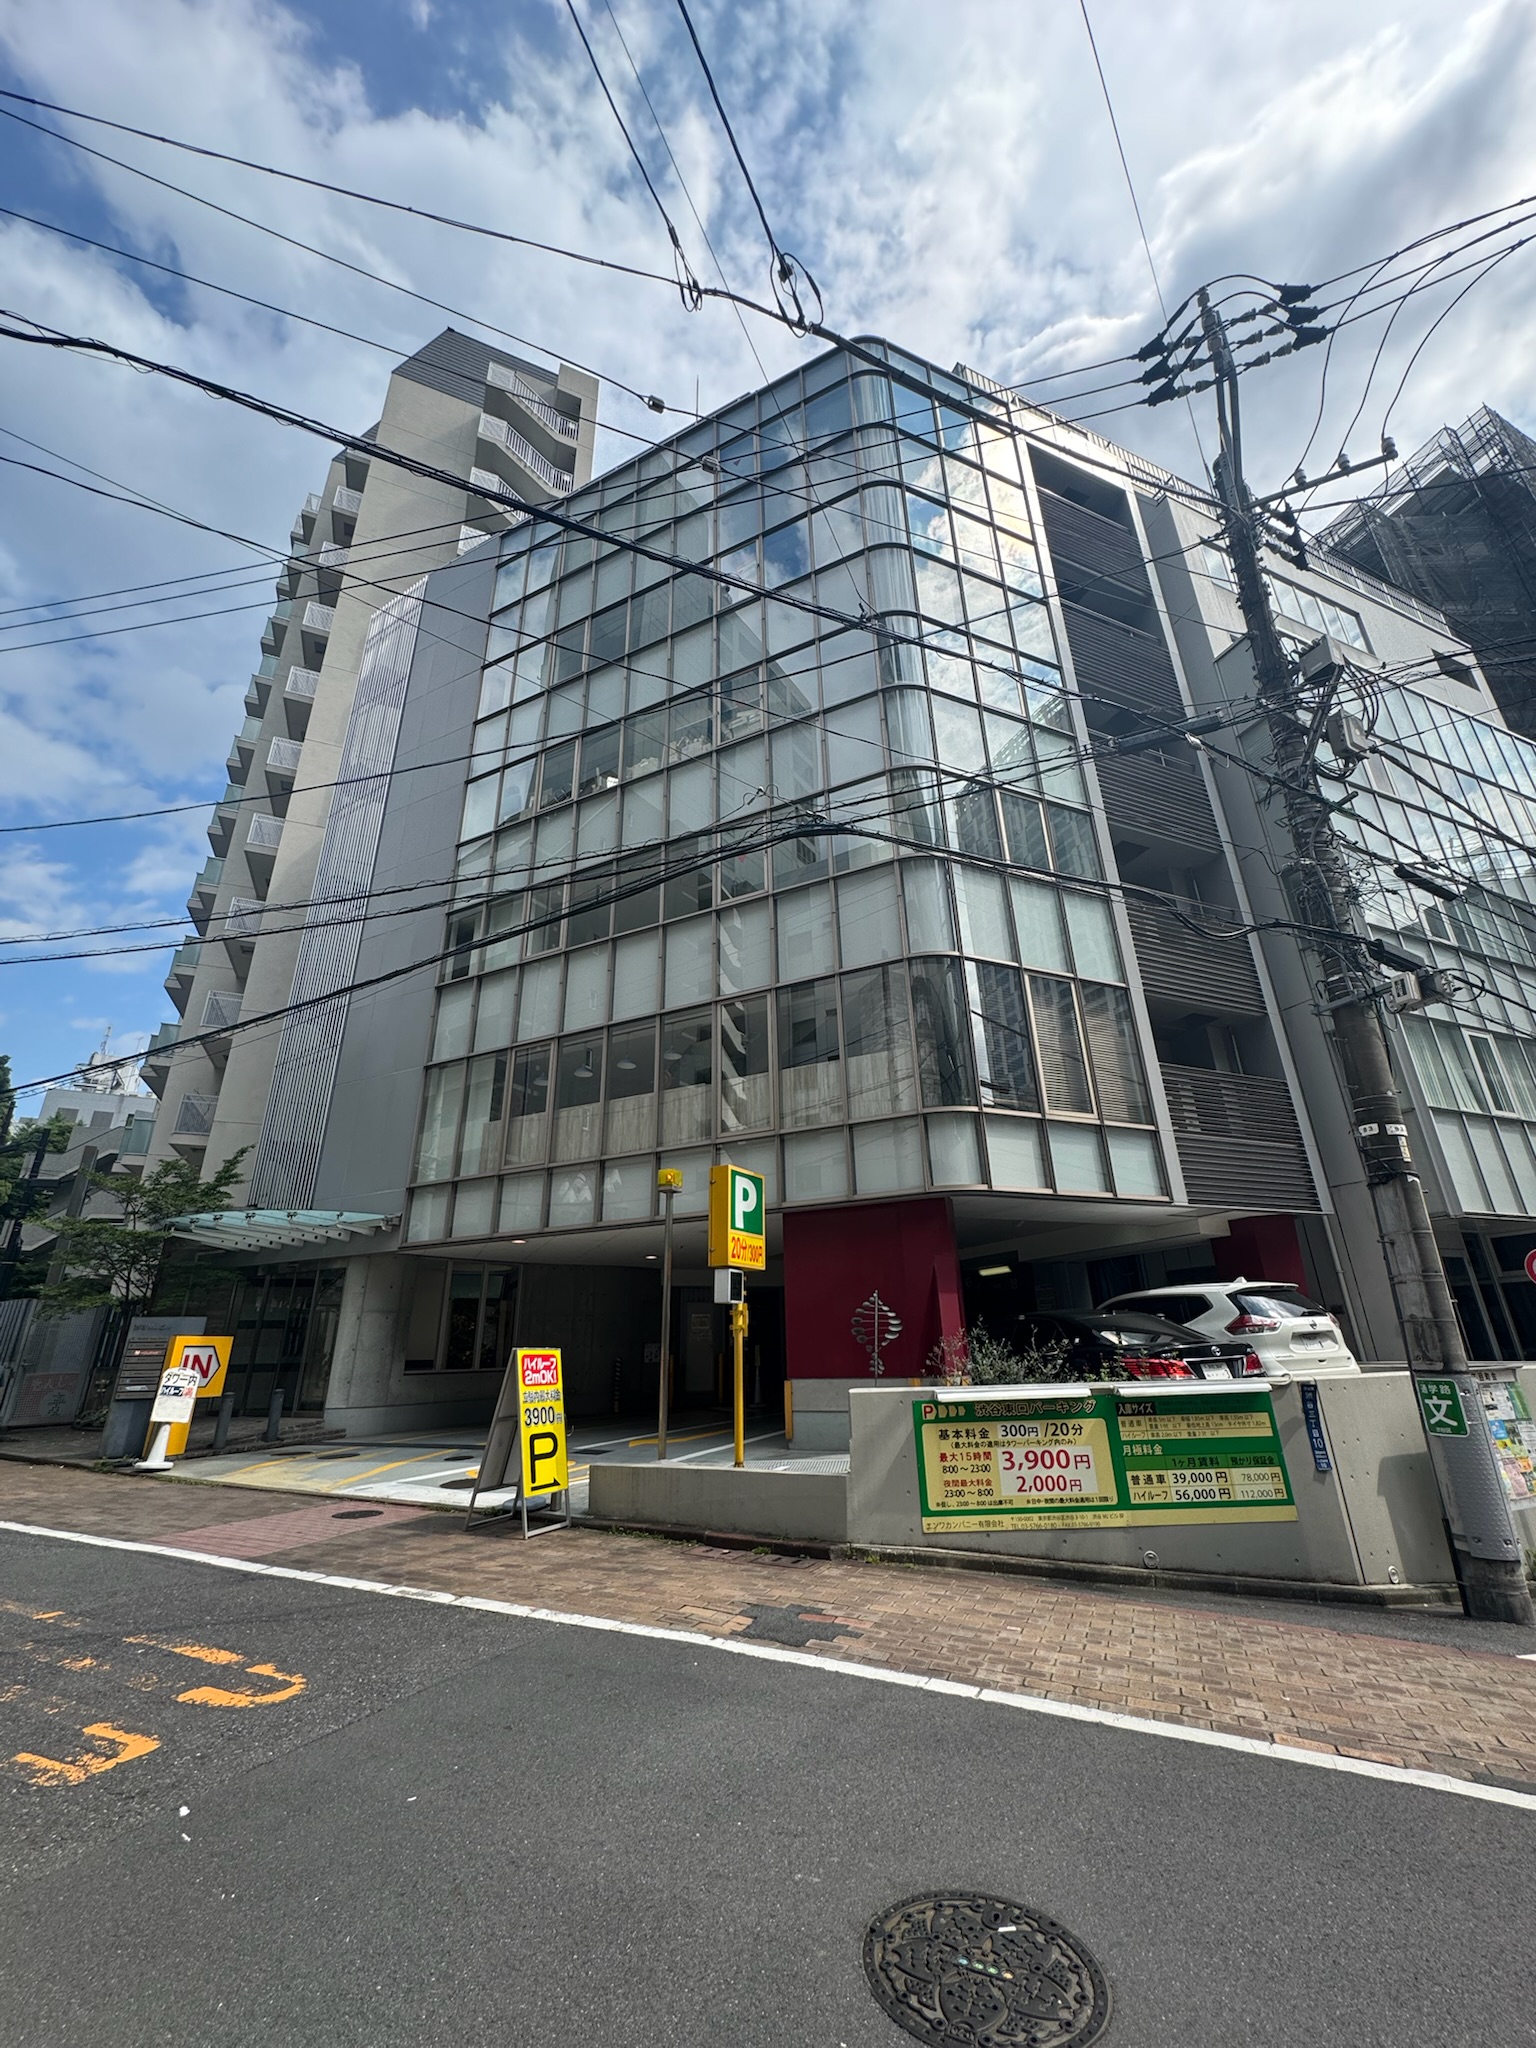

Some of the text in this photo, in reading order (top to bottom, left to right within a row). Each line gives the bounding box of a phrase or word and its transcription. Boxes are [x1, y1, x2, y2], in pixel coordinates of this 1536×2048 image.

[735, 1174, 757, 1229] P
[182, 1354, 213, 1379] IN
[523, 1357, 557, 1371] ハイルーフ
[164, 1371, 198, 1386] タワー内
[524, 1370, 557, 1385] 2mOK!
[1420, 1383, 1452, 1395] 通学路
[923, 1405, 934, 1419] P
[974, 1398, 1097, 1417] 渋谷東口パーキング
[1118, 1402, 1154, 1415] 入庫サイズ
[1424, 1395, 1459, 1427] 文
[524, 1405, 563, 1427] 3900円
[938, 1422, 1084, 1440] 基本料金 300円 /20分
[1122, 1443, 1164, 1456] 月極料金
[1312, 1438, 1324, 1449] 10
[529, 1431, 559, 1484] P
[939, 1448, 1092, 1471] 最大15時間 3,900円
[1230, 1455, 1276, 1467] 預かり保証金
[943, 1474, 1083, 1493] 夜間最大料金 2,000円
[1130, 1471, 1282, 1487] 普通車 39,000円 78,000円
[1132, 1486, 1286, 1502] ハイルーフ 56,000円 112,000円
